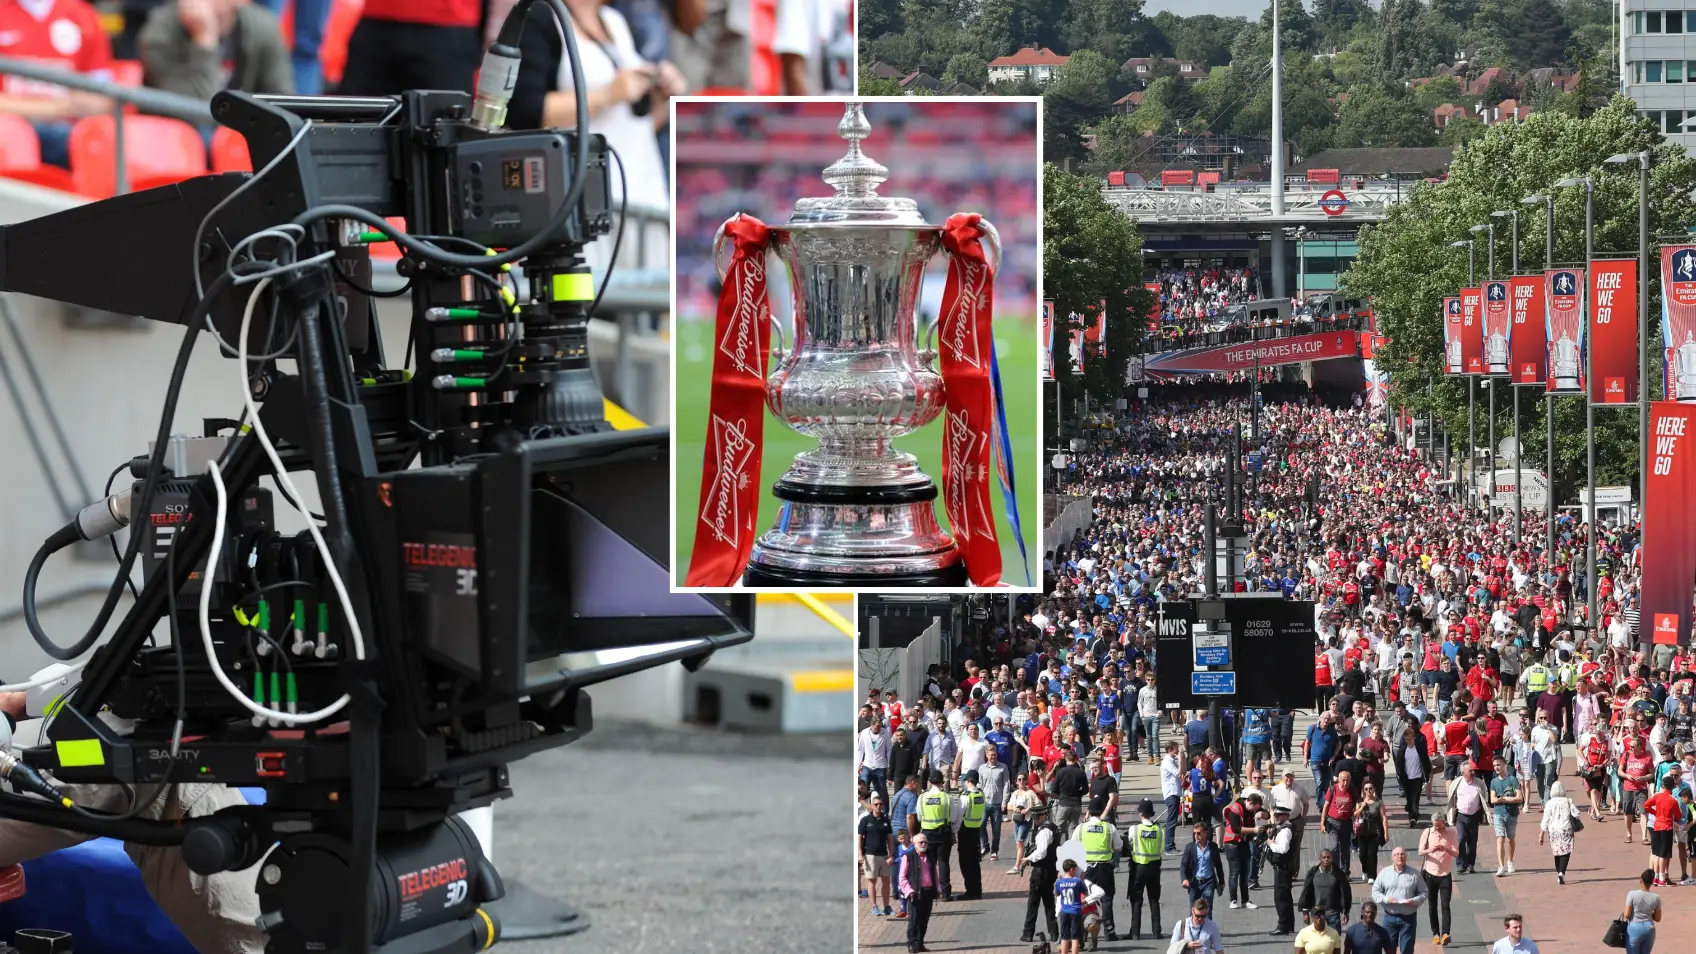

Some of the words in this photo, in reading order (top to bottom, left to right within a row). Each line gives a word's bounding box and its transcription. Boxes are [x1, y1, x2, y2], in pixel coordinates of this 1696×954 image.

[1596, 272, 1623, 289] HERE
[1514, 285, 1535, 298] HERE
[1597, 290, 1615, 307] WE
[1464, 295, 1480, 306] HERE
[1515, 298, 1528, 311] WE
[735, 251, 765, 372] Budweiser
[1464, 306, 1475, 316] WE
[1515, 311, 1527, 324] GO
[1597, 307, 1612, 324] GO
[1464, 316, 1474, 326] GO
[1225, 350, 1244, 363] THE
[1246, 345, 1291, 361] EMIRATES
[1292, 343, 1303, 354] FA
[1305, 340, 1323, 353] CUP
[1656, 416, 1688, 436] HERE
[1656, 436, 1677, 456] WE
[1654, 456, 1672, 476] GO
[712, 418, 746, 542] Budweiser
[1529, 492, 1541, 500] UP
[1159, 618, 1187, 636] MVIS
[1243, 628, 1274, 637] 580570
[1246, 620, 1271, 628] 01629
[1199, 777, 1207, 791] 8
[1087, 825, 1103, 833] POLICE
[398, 858, 467, 896] TELEGENIC
[443, 879, 468, 908] 3D
[1061, 888, 1075, 905] 10
